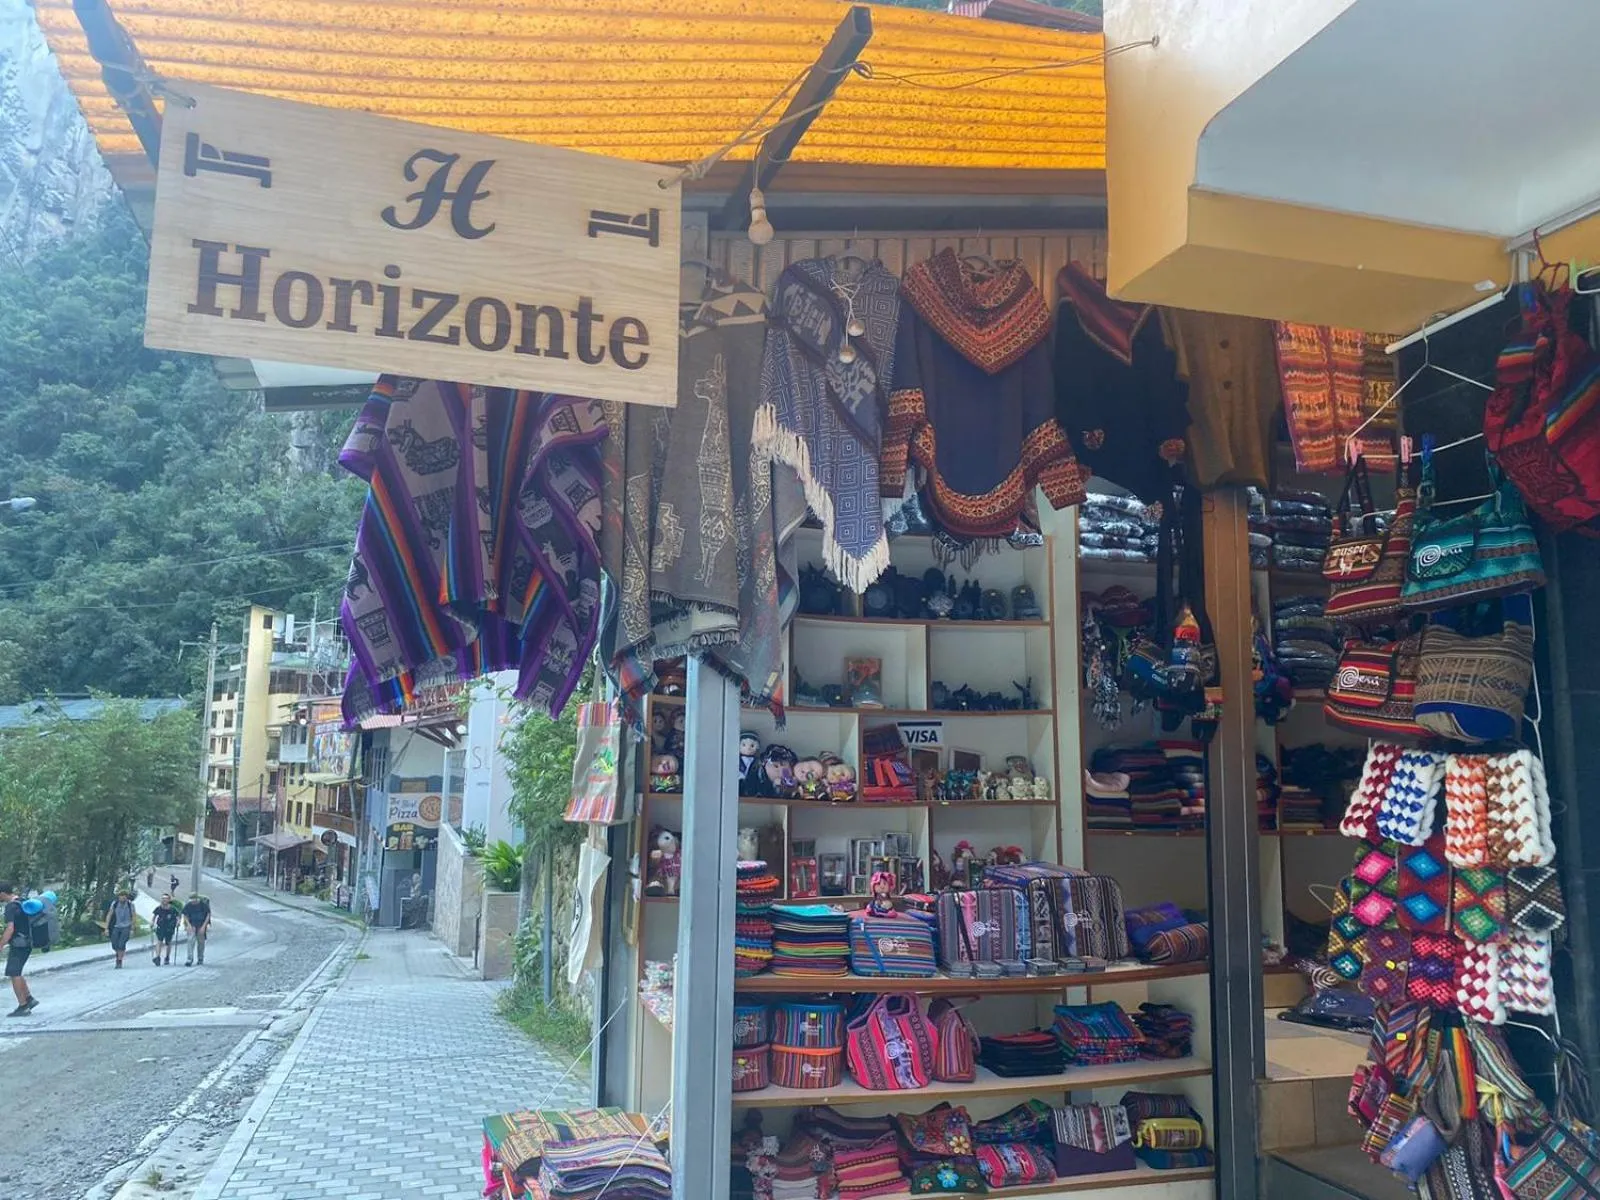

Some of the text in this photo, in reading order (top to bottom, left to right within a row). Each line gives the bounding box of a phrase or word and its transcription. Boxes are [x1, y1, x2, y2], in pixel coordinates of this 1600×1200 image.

[380, 147, 497, 241] H
[187, 238, 651, 370] Horizonte
[903, 730, 938, 743] VISA
[388, 806, 418, 820] Pizza
